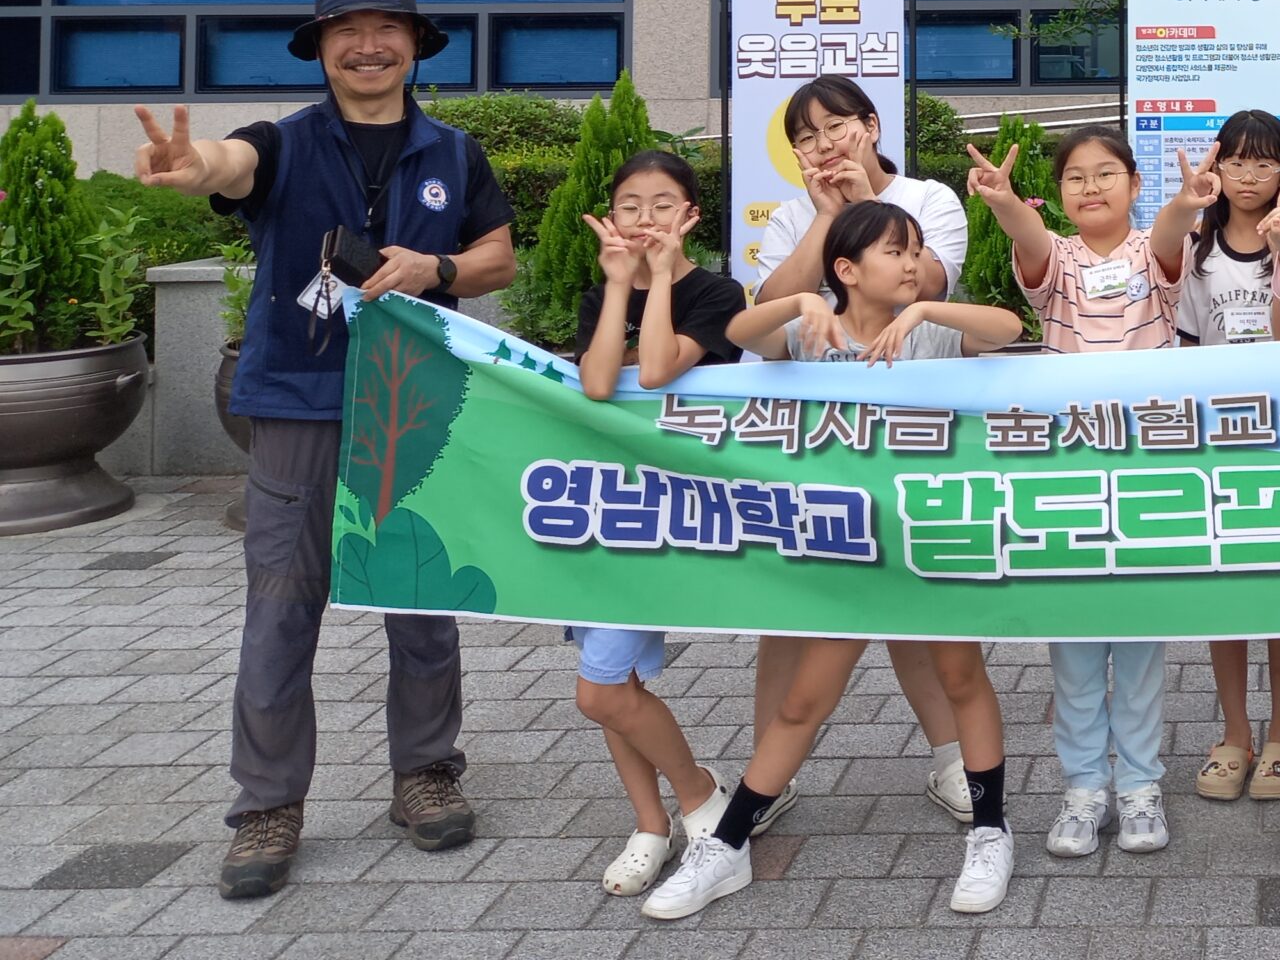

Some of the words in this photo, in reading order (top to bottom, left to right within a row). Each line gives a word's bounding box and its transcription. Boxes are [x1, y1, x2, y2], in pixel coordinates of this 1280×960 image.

[1156, 27, 1197, 38] 아카데미
[737, 32, 900, 79] 웃음교실
[749, 209, 770, 222] 일시
[521, 458, 877, 563] 영남대학교
